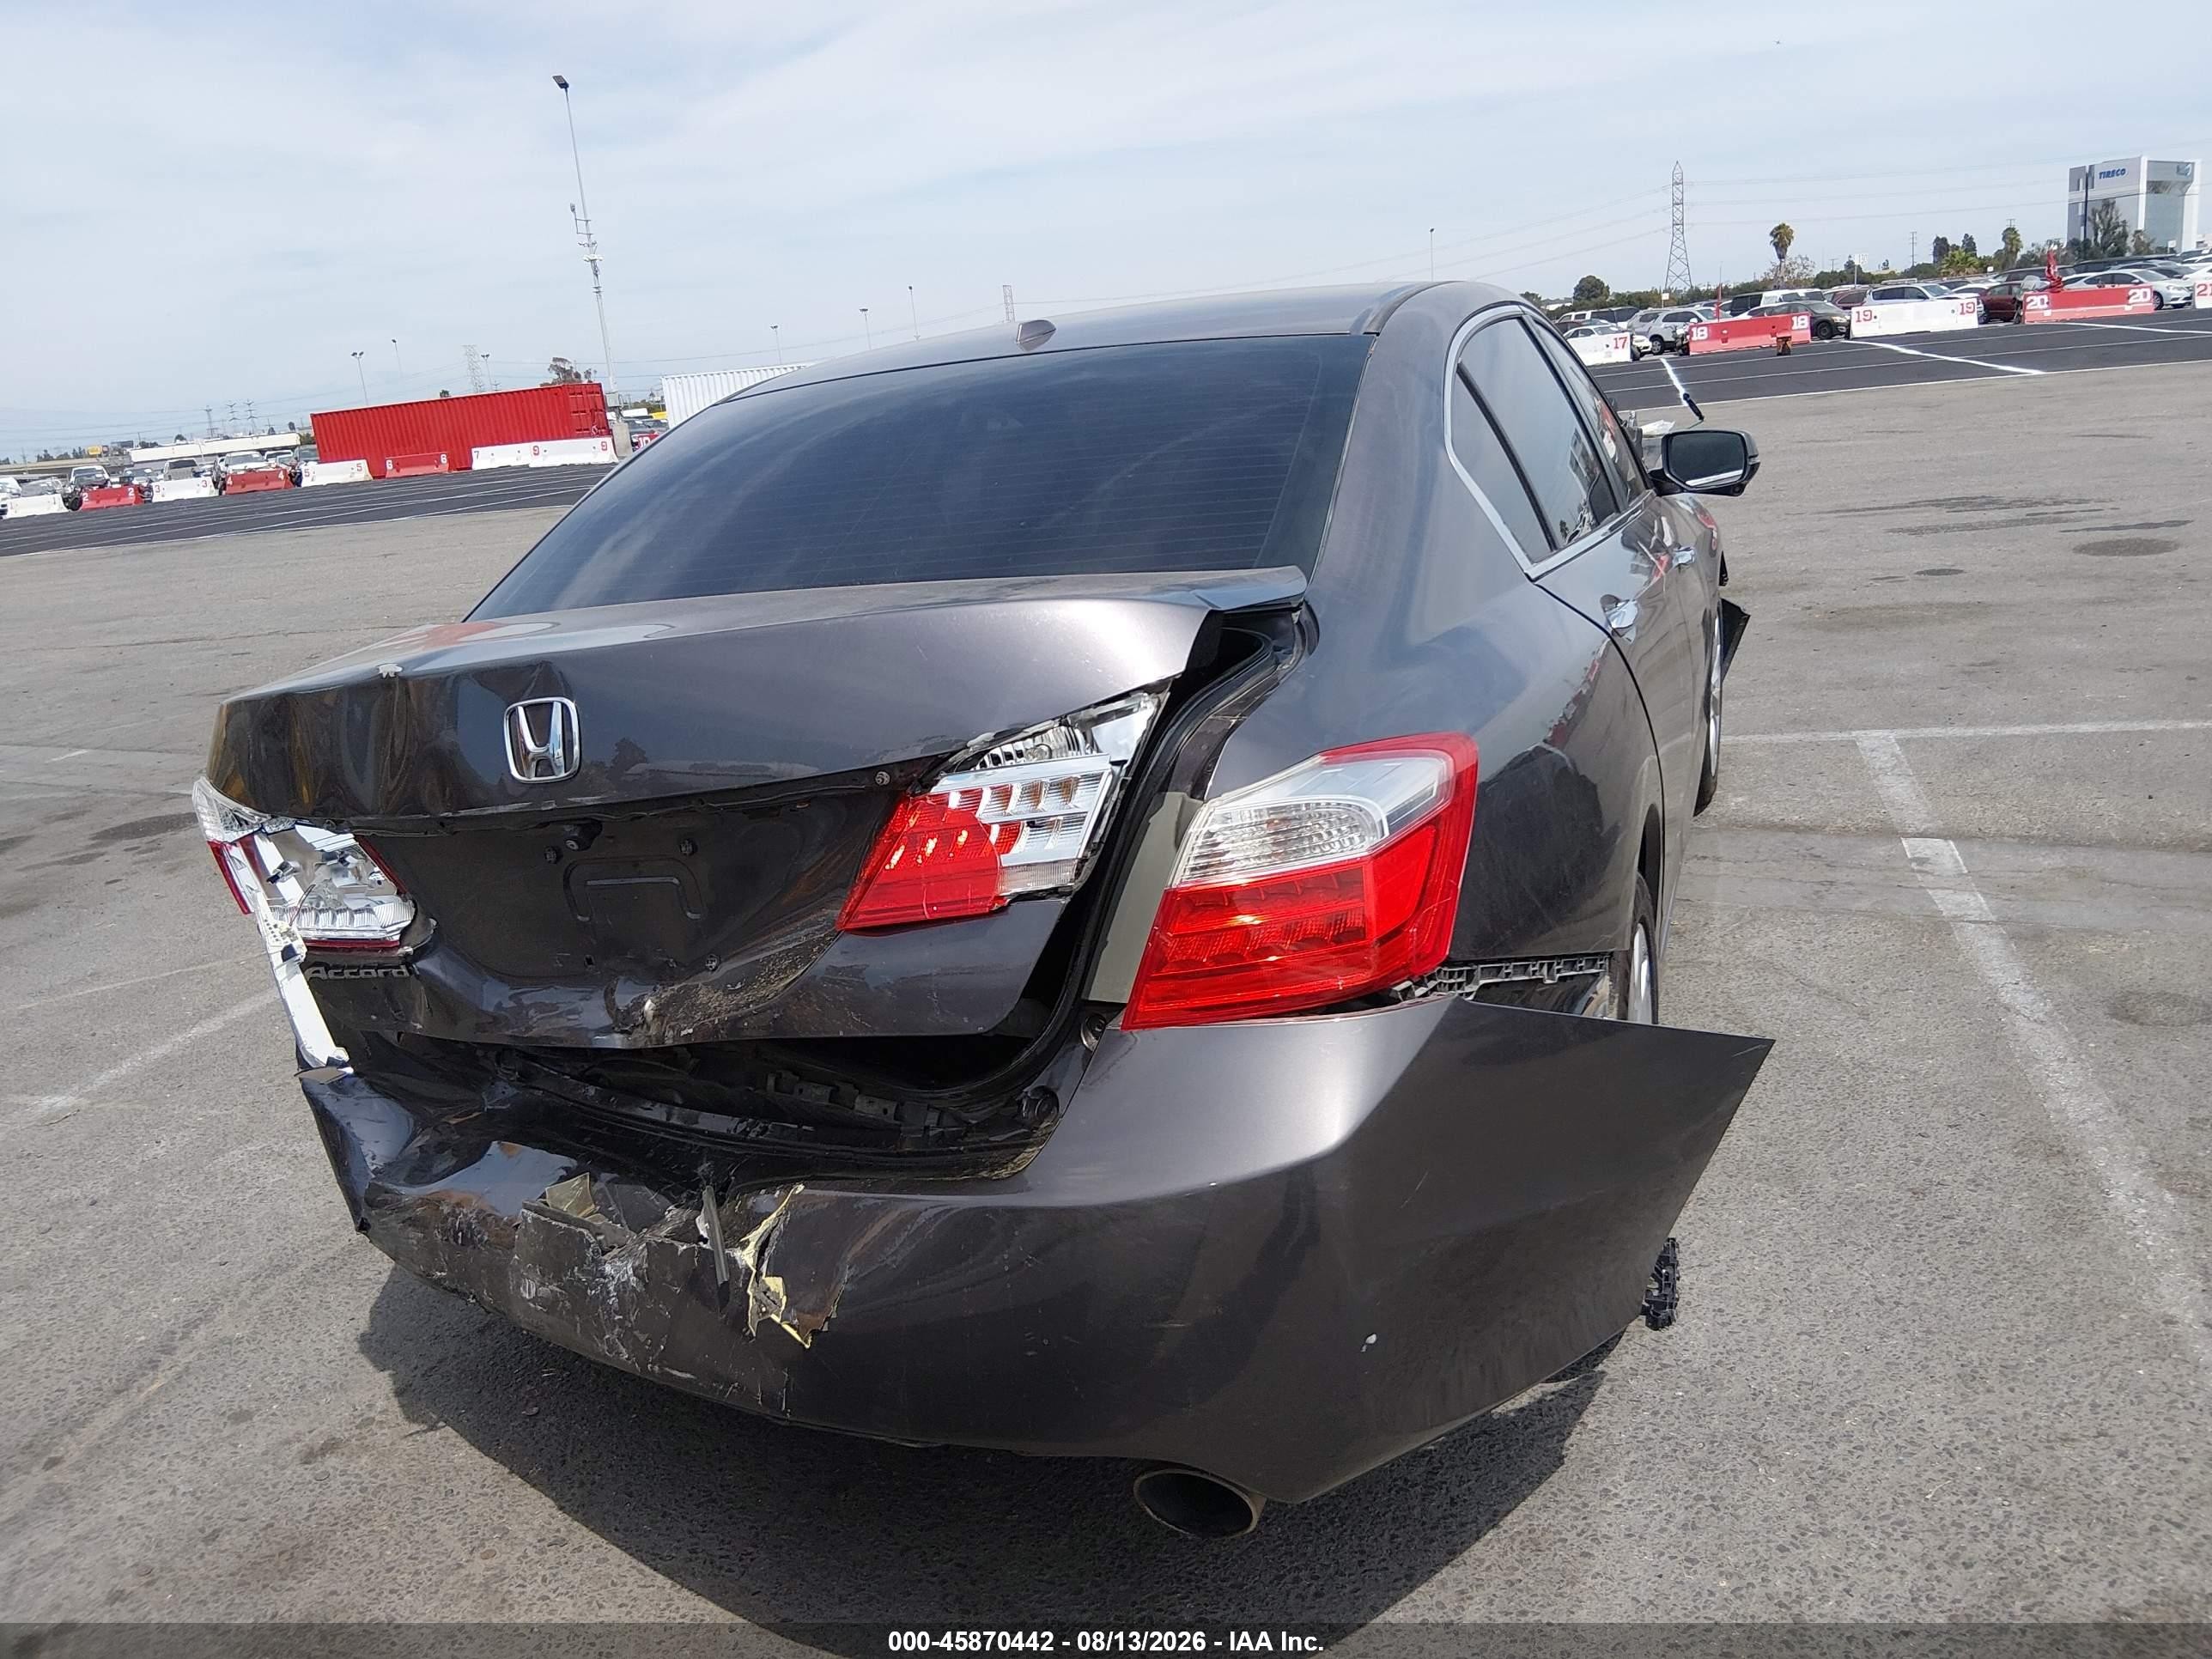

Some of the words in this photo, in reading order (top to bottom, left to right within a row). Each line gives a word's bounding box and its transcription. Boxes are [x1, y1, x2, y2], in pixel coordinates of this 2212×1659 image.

[2099, 168, 2126, 179] TIRECO
[2128, 288, 2151, 303] 20
[2026, 295, 2049, 309] 20
[1960, 301, 1976, 315] 19
[1855, 309, 1873, 323] 19
[1792, 315, 1808, 330] 18
[1691, 326, 1708, 341] 18
[1613, 337, 1628, 349] 17
[474, 450, 480, 459] 7
[356, 463, 362, 471] 5
[277, 471, 284, 481] 4
[304, 468, 310, 477] 5
[202, 479, 208, 488] 3
[227, 477, 233, 486] 4
[127, 487, 135, 496] 2
[155, 484, 161, 493] 3
[82, 492, 88, 501] 2
[304, 964, 410, 980] Accord
